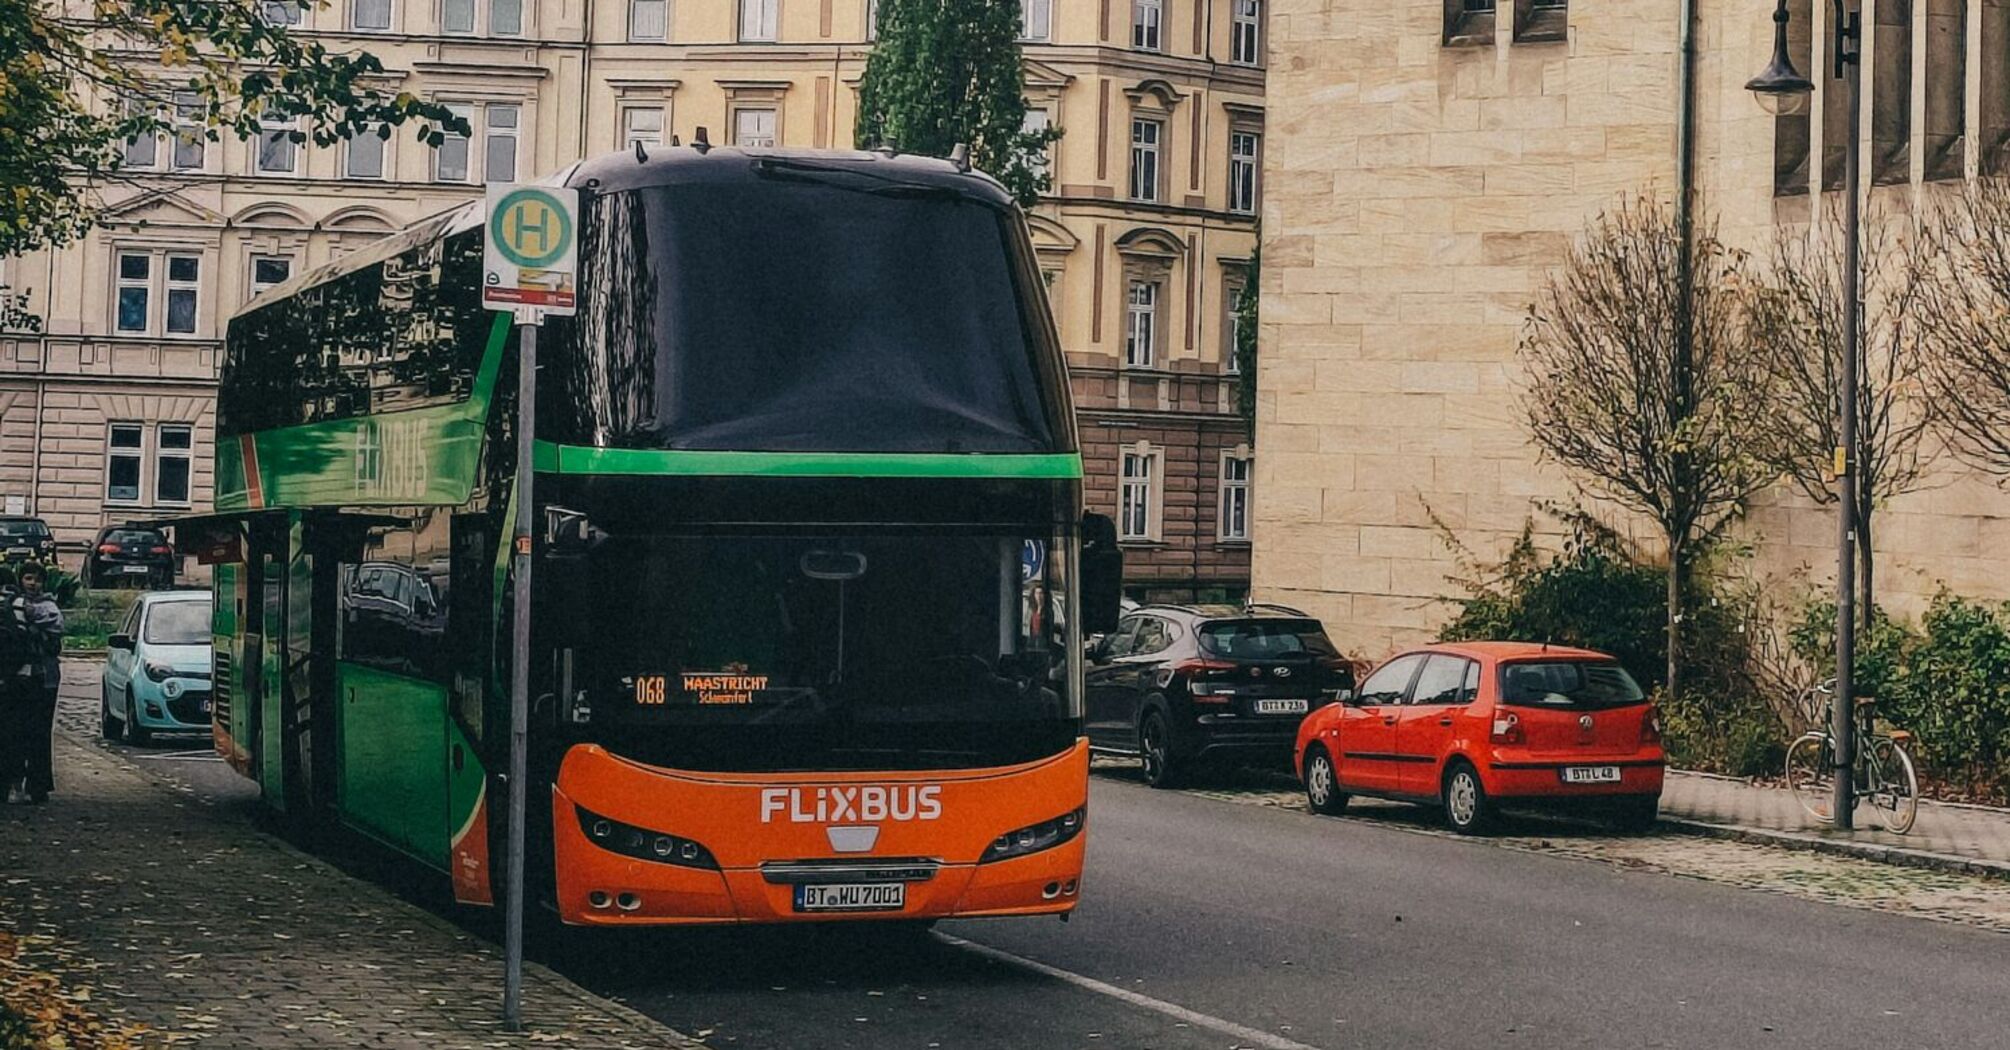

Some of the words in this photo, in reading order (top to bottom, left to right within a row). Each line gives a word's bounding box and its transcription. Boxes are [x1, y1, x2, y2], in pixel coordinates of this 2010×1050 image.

[515, 206, 548, 251] H
[636, 676, 665, 704] 068
[684, 676, 767, 690] MAASTRICHT
[1573, 768, 1587, 779] BT
[806, 888, 827, 905] BT
[863, 886, 900, 903] 7001
